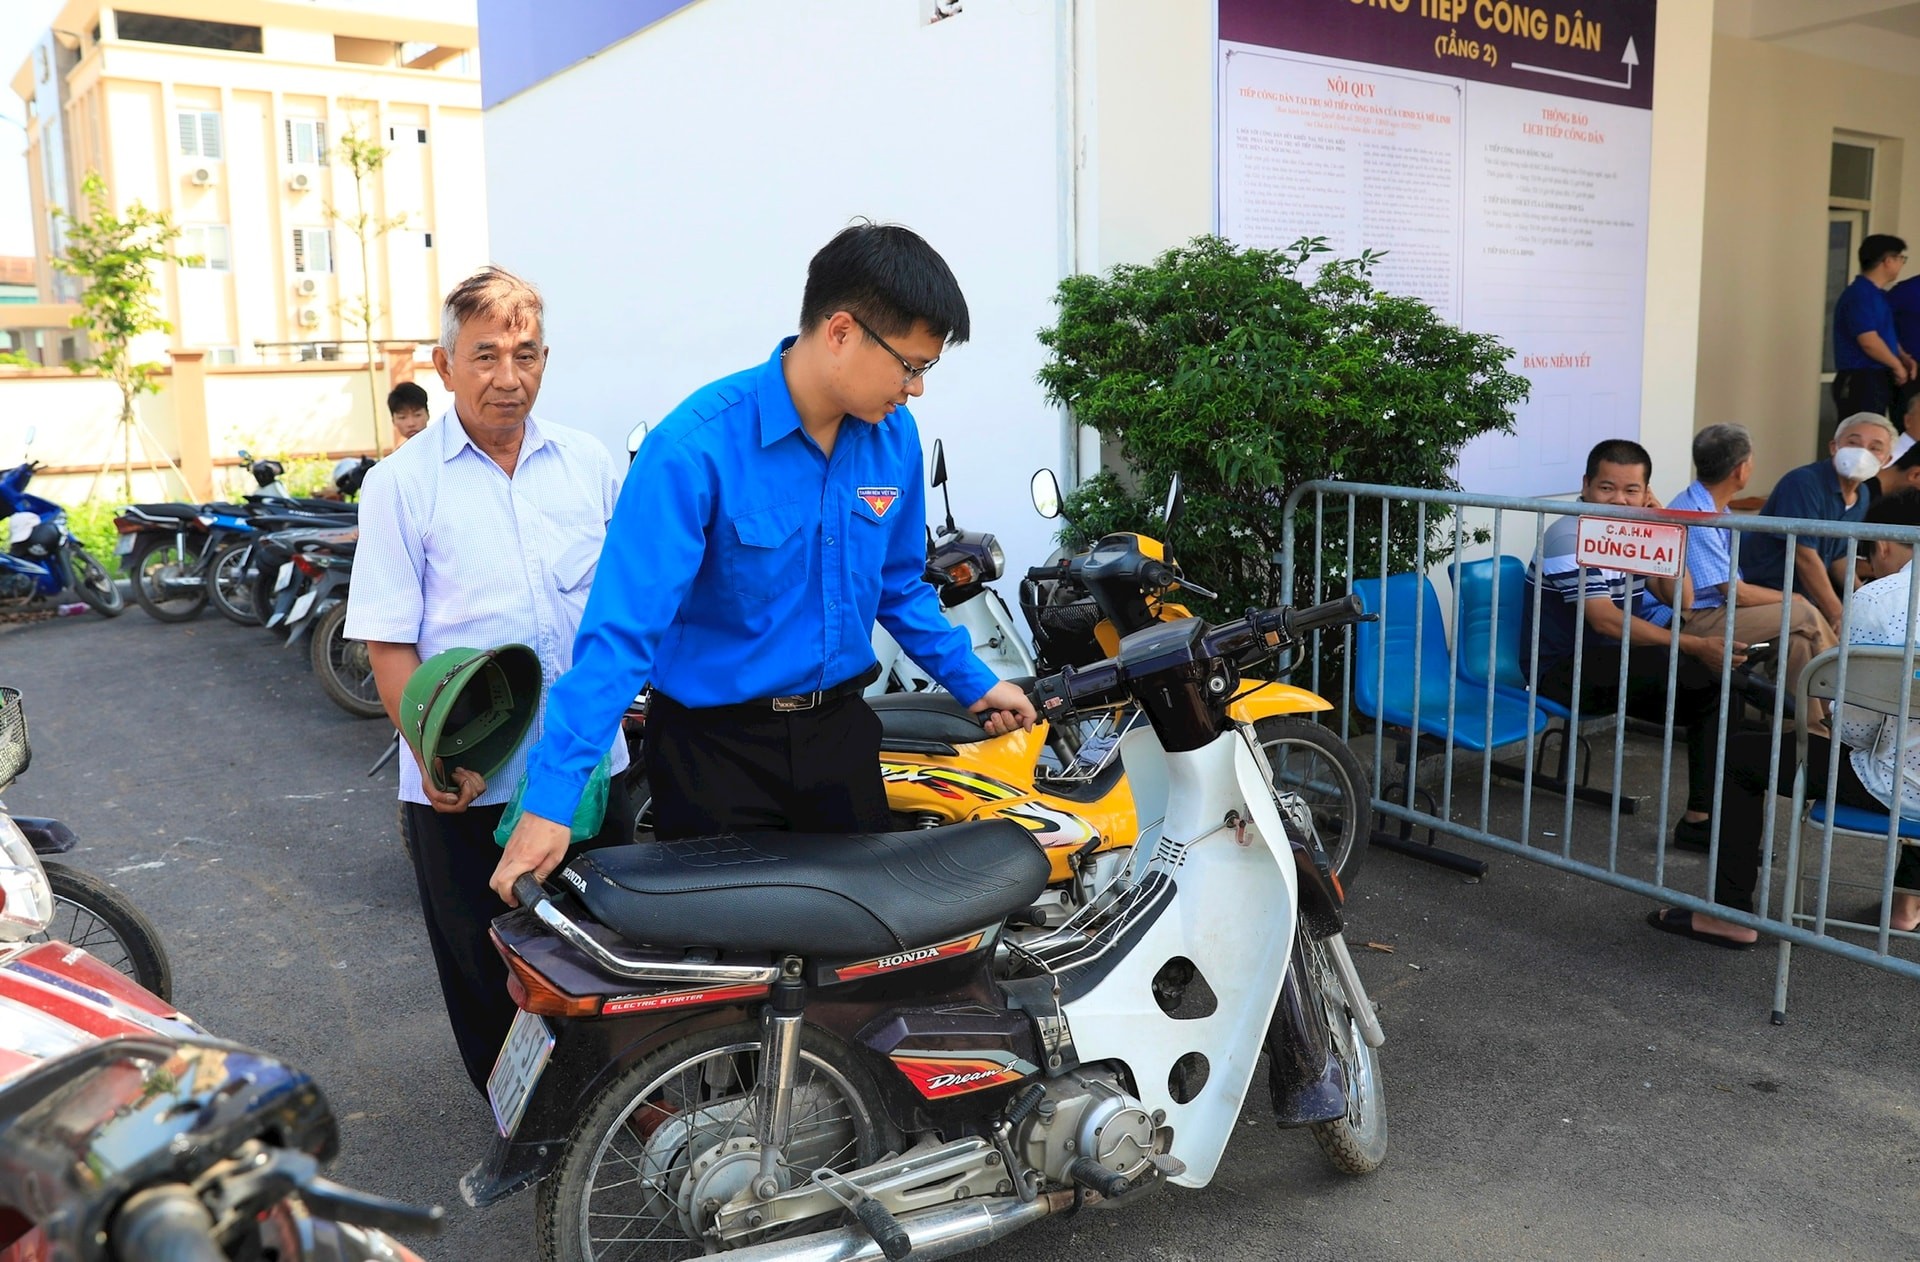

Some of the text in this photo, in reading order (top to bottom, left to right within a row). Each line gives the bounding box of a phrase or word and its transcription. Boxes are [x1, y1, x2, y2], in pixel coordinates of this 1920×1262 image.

[1554, 10, 1601, 51] DÂN
[1434, 29, 1498, 67] (TẦNG 2)
[1327, 75, 1375, 98] NỘI QUY
[1542, 108, 1570, 124] THÔNG
[1546, 124, 1563, 138] TIẾP
[1564, 127, 1586, 141] CÔNG
[1588, 130, 1604, 143] DÂN
[1550, 353, 1572, 368] NIÊM
[1575, 351, 1591, 368] YẾT
[1606, 525, 1652, 538] C.A.H.N
[1585, 536, 1673, 565] DỪNG LẠI
[877, 948, 939, 968] HONDA
[611, 994, 704, 1010] ELECTRIC STARTER
[927, 1069, 1002, 1090] Dream
